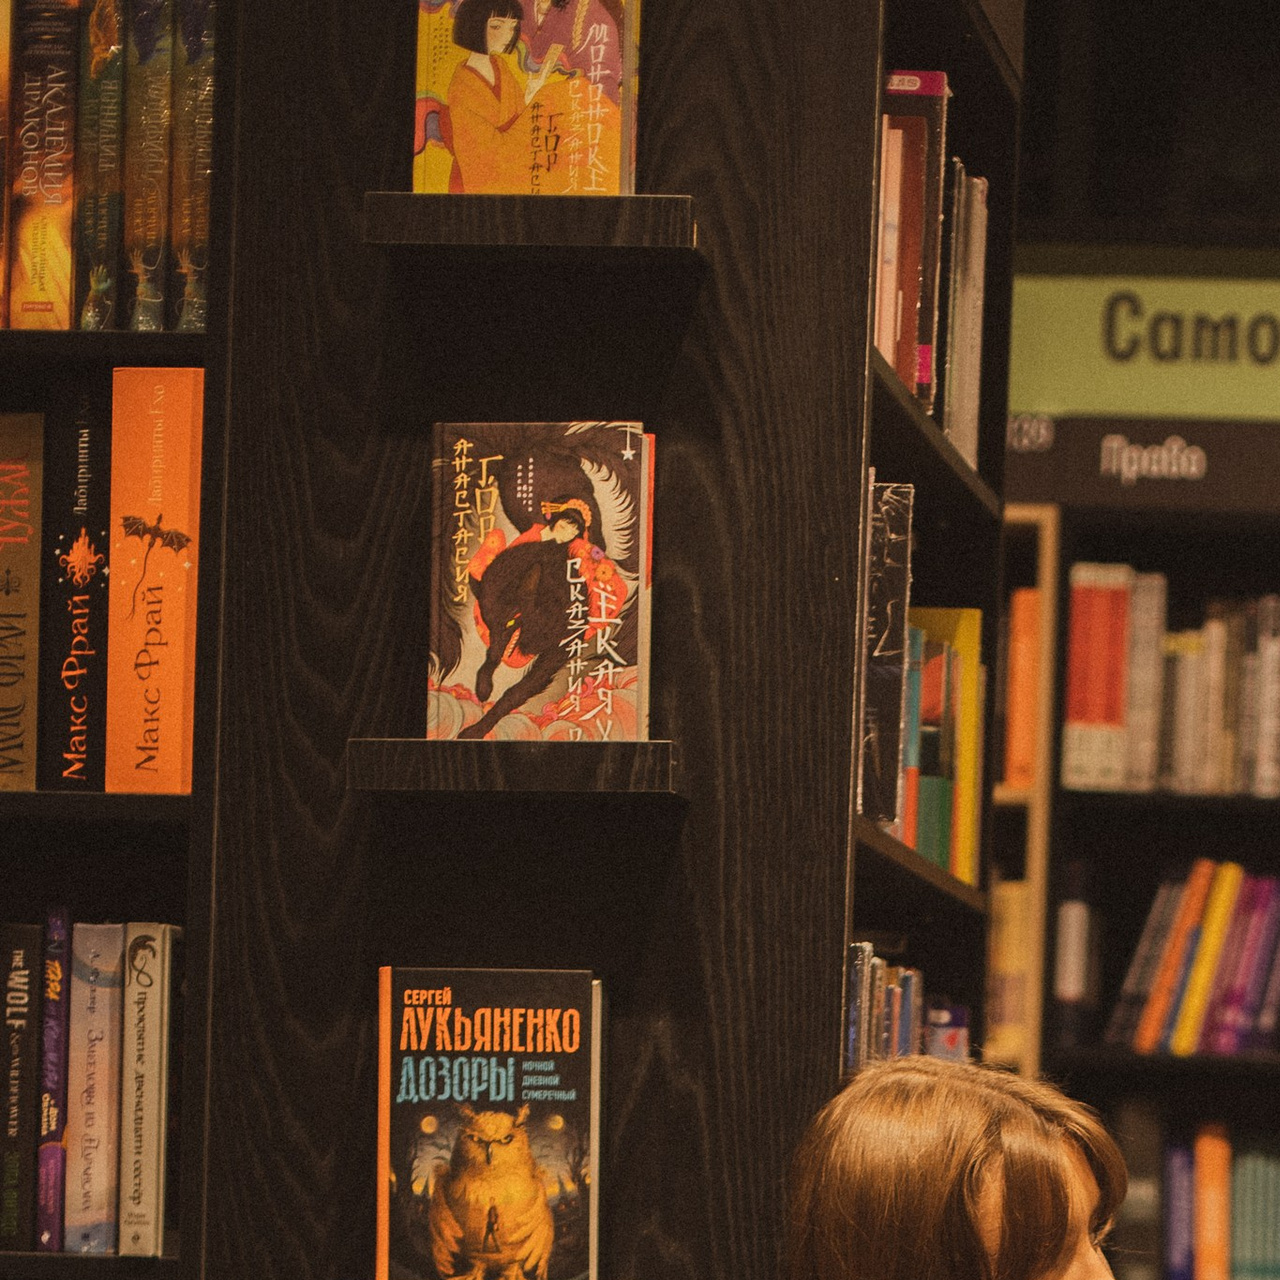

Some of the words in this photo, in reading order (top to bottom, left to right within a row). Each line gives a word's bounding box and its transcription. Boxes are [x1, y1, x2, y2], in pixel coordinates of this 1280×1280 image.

[19, 71, 42, 198] ДРАКОНОВ
[40, 63, 69, 206] АКАДЕМИЯ
[545, 113, 563, 172] ГОР
[562, 79, 585, 194] СКАЗАНИЯ
[575, 23, 611, 192] МОНОНОКЕ
[72, 428, 90, 516] Лабиринты
[148, 418, 166, 508] Лабиринты
[475, 455, 504, 543] ГОР
[1100, 434, 1208, 486] Право
[451, 438, 474, 602] АНАСТАСИЯ
[61, 593, 95, 691] Фрай
[133, 585, 168, 681] Фрай
[559, 557, 588, 716] СКАЗАНИЯ
[61, 694, 88, 781] Макс
[135, 687, 161, 773] Макс
[6, 969, 30, 1031] WOLF
[12, 949, 24, 968] THE
[403, 986, 452, 1005] СЕРГЕЙ
[399, 1006, 581, 1053] ЛУКЬЯНЕНКО
[522, 1059, 555, 1071] НОЧНОЙ
[396, 1055, 515, 1104] ДОЗОРЫ
[521, 1074, 560, 1086] ДНЕВНОЙ
[521, 1088, 577, 1101] СУМЕРЕЧНЫЙ
